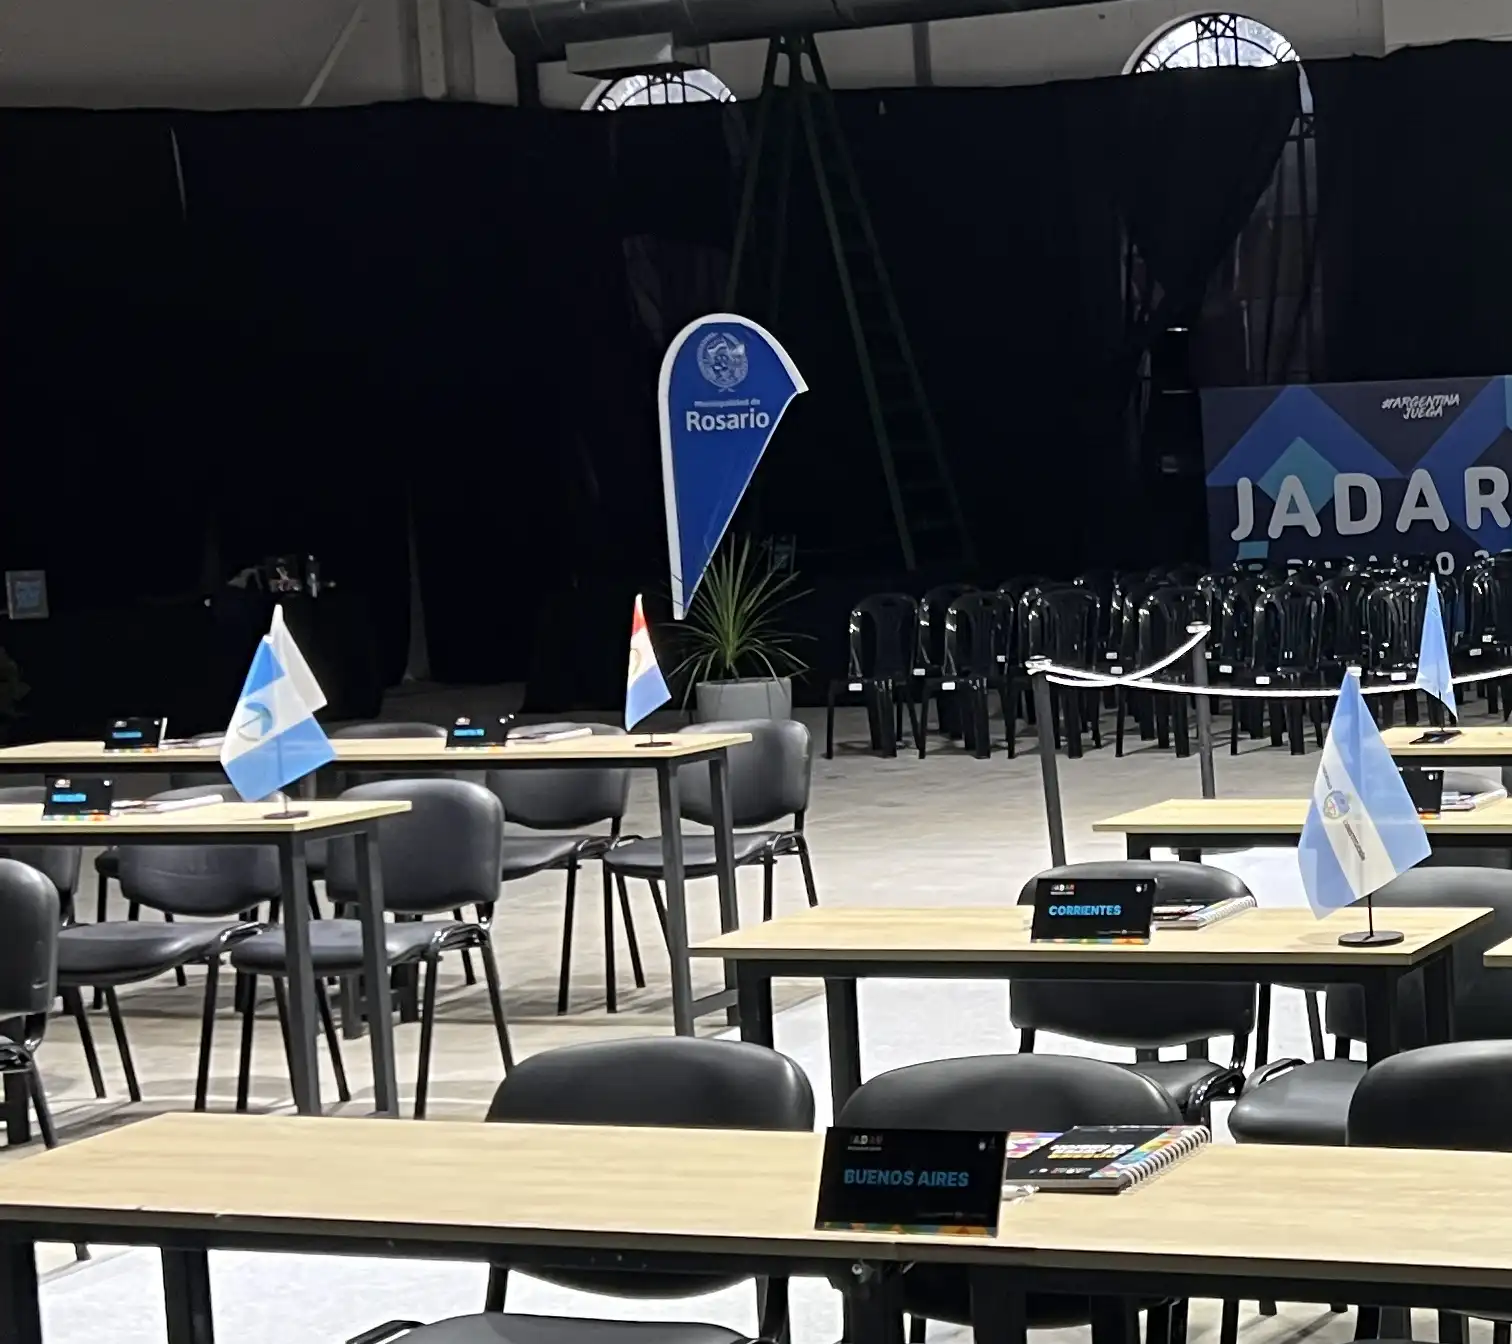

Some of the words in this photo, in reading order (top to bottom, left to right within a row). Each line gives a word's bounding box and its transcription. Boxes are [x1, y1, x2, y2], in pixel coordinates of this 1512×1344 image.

[1381, 393, 1460, 408] #ARGENTINA
[685, 409, 770, 432] Rosario
[1403, 405, 1443, 420] JUEGA
[1231, 466, 1511, 541] JADAR
[1049, 905, 1121, 916] CORRIENTES
[843, 1168, 915, 1187] BUENOS
[917, 1169, 970, 1188] AIRES
